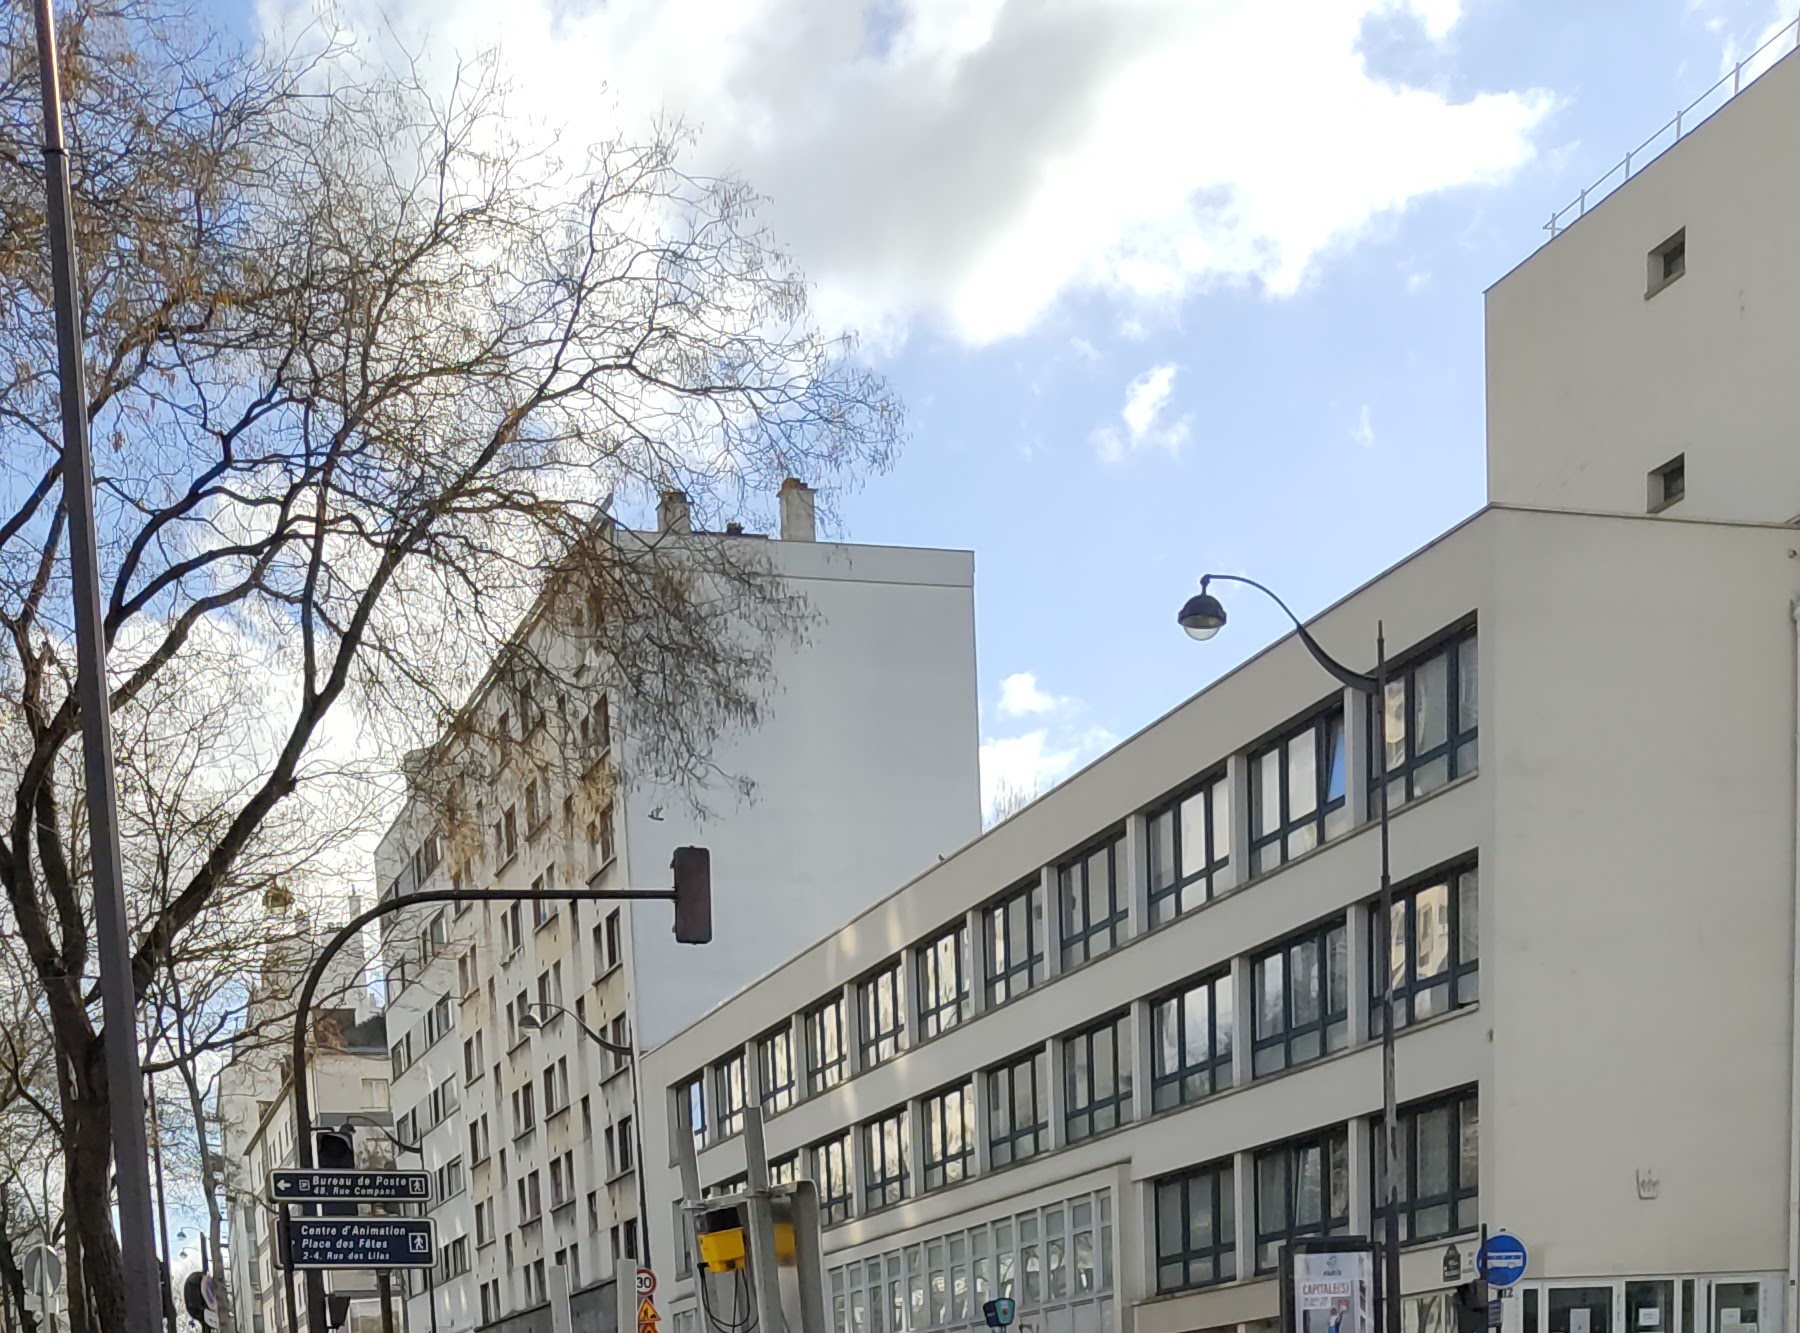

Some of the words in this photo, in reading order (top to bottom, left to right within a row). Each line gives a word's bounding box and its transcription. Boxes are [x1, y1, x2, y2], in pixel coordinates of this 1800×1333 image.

[312, 1175, 352, 1186] Bureau
[357, 1175, 371, 1186] de
[376, 1175, 407, 1186] Poste
[333, 1186, 350, 1195] Rue
[354, 1186, 396, 1197] Compans
[301, 1225, 337, 1236] Centre
[341, 1225, 406, 1236] d'Animation
[302, 1238, 331, 1249] Place
[335, 1238, 354, 1249] des
[359, 1238, 388, 1249] Fêtes
[326, 1251, 344, 1260] Rue
[347, 1251, 364, 1260] des
[636, 1276, 652, 1289] 30
